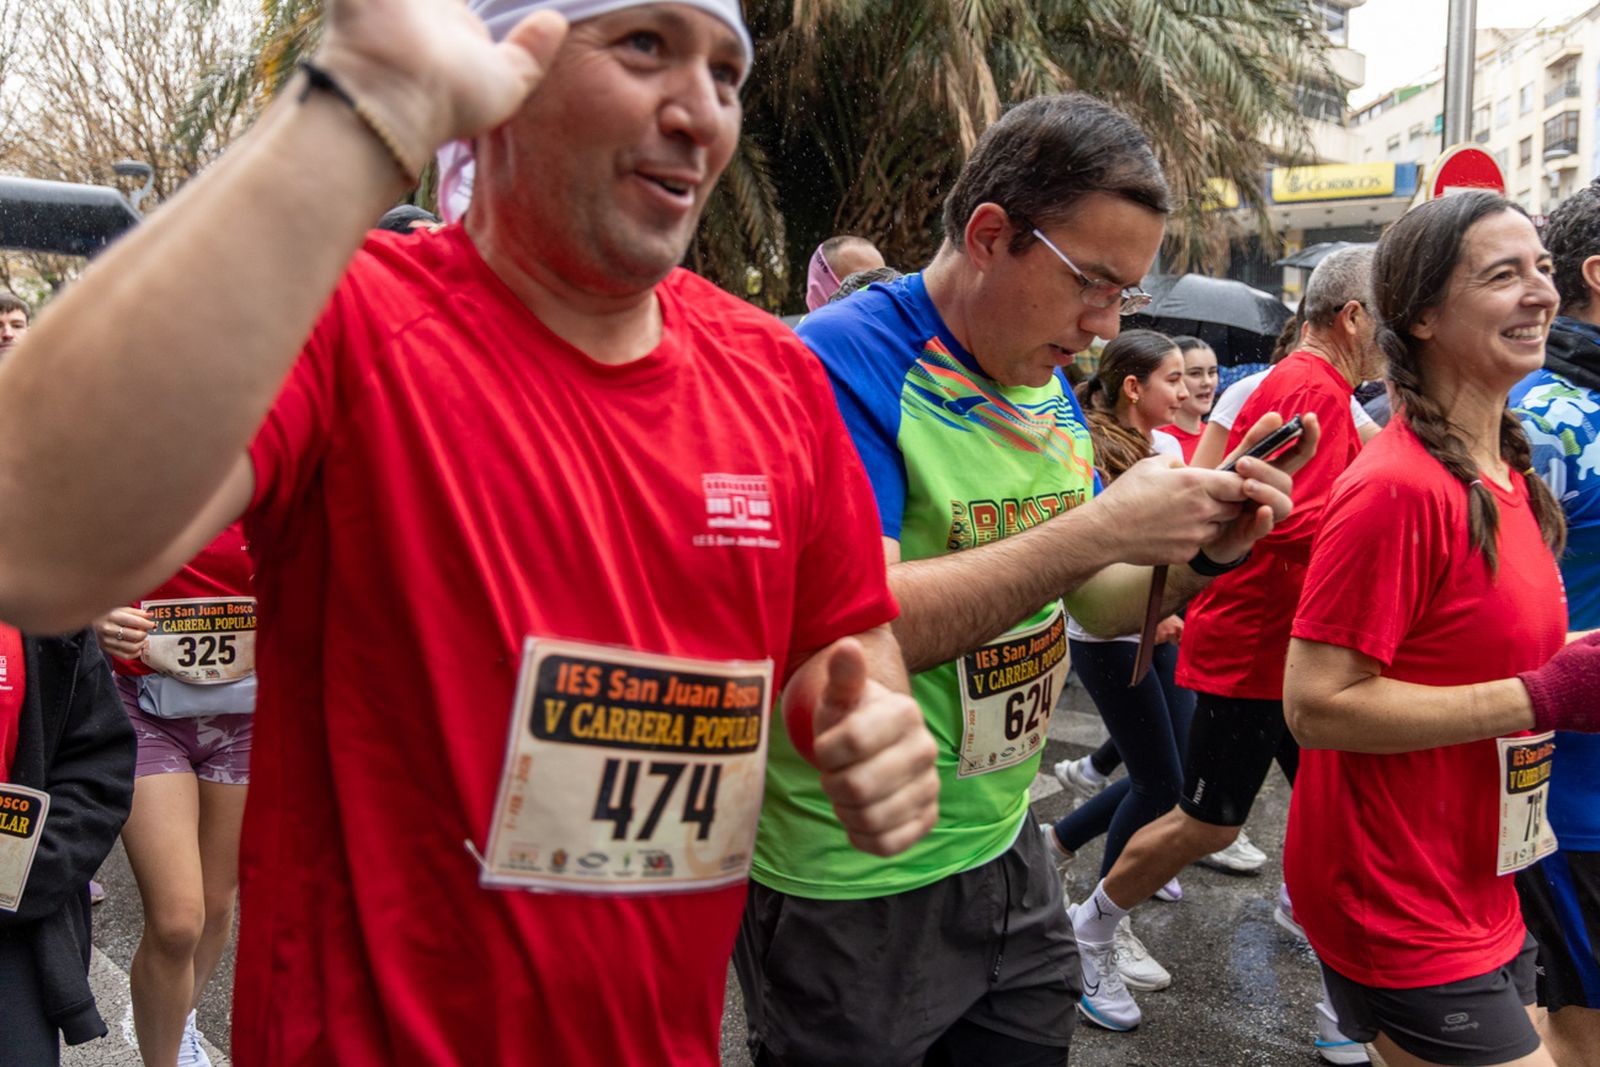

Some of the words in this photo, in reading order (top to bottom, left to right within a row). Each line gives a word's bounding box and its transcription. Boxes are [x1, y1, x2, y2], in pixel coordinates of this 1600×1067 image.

[154, 607, 171, 618] IES
[174, 607, 195, 618] San
[198, 604, 224, 616] Juan
[227, 603, 253, 615] Bosco
[162, 617, 212, 633] CARRERA
[177, 635, 236, 667] 325
[975, 648, 999, 669] IES
[1003, 644, 1026, 664] San
[556, 662, 602, 698] IES
[608, 669, 658, 704] San
[662, 676, 720, 708] Juan
[973, 673, 984, 695] V
[988, 657, 1040, 690] CARRERA
[544, 698, 566, 735] V
[570, 701, 685, 747] CARRERA
[1005, 672, 1053, 741] 624
[592, 758, 722, 840] 474
